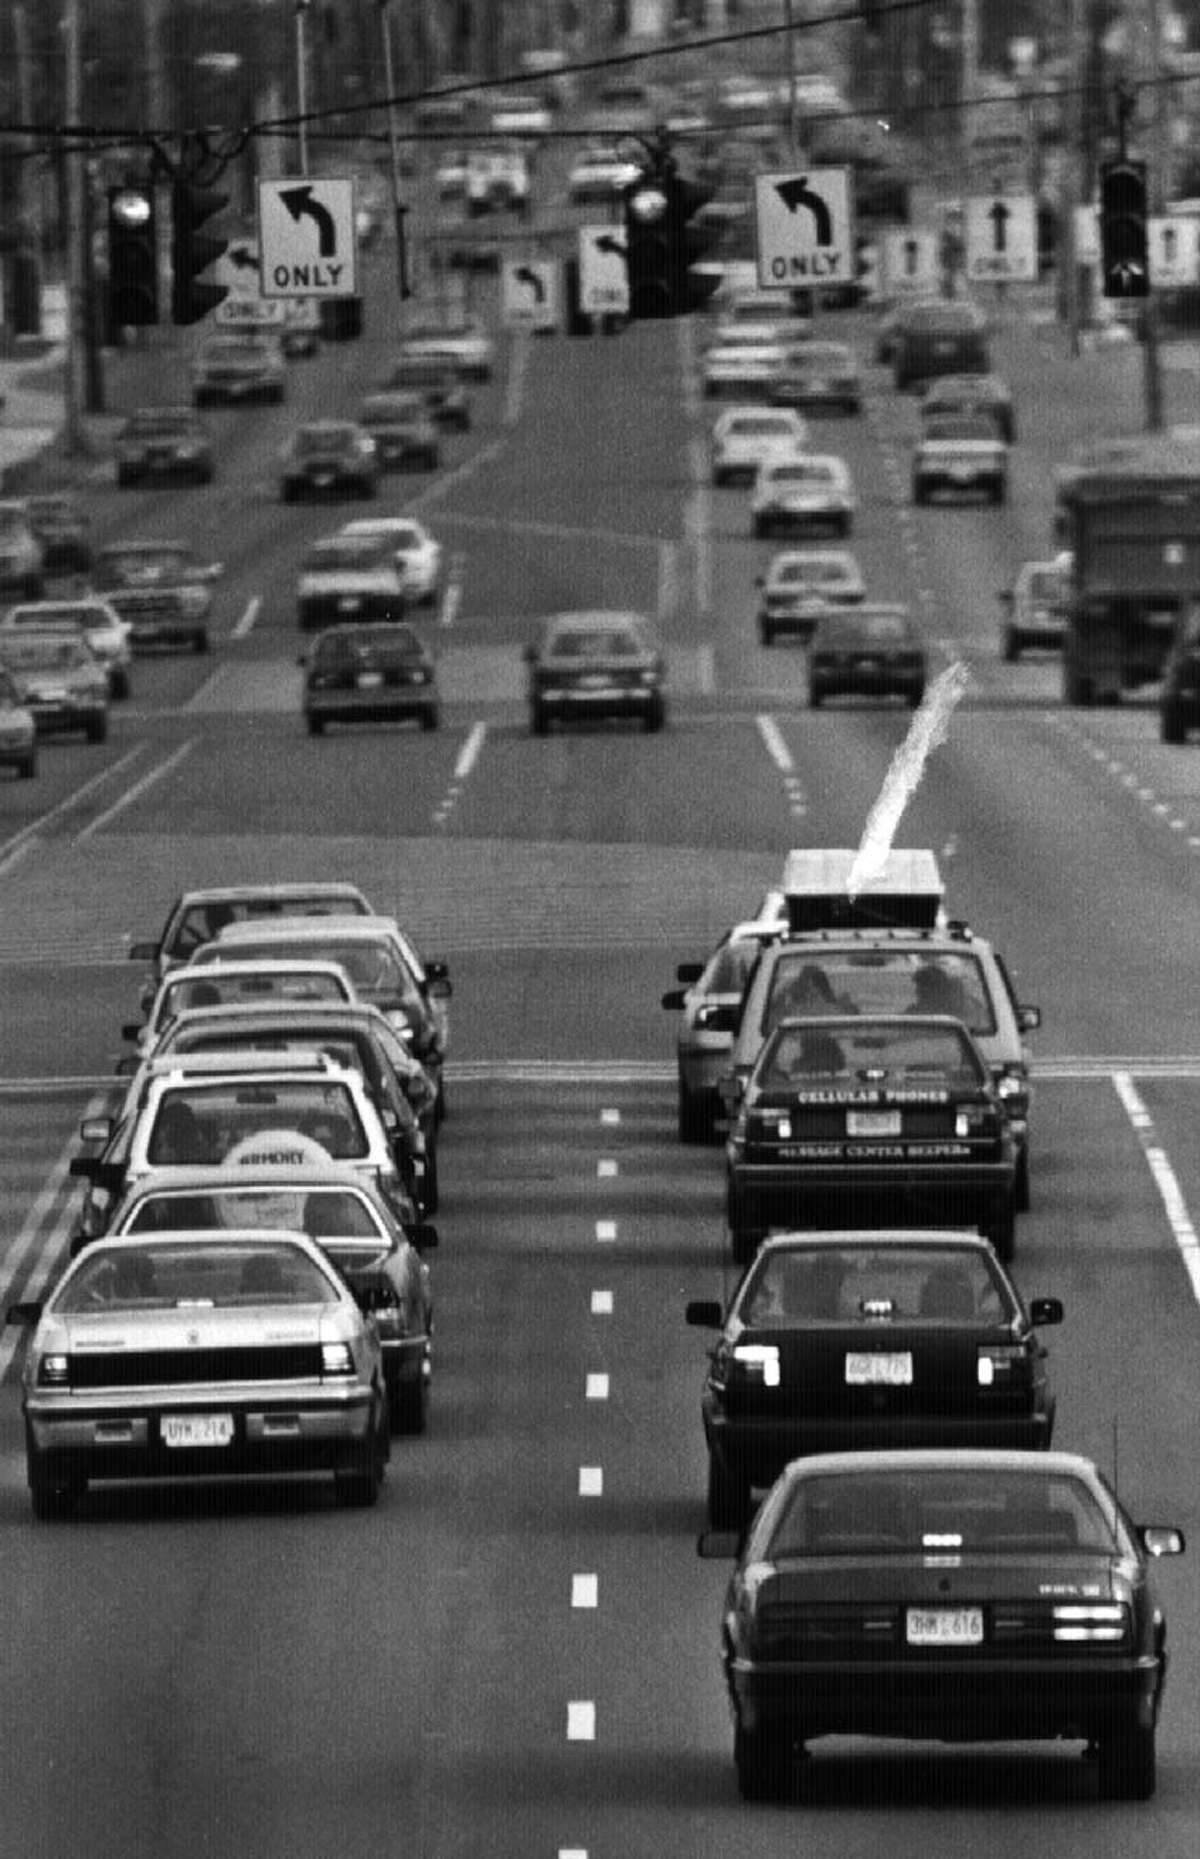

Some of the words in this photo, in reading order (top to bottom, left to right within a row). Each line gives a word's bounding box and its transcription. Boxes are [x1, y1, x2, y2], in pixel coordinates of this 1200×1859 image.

[273, 264, 343, 287] ONLY
[773, 252, 840, 279] ONLY
[798, 1090, 879, 1104] CELLULAR
[885, 1090, 948, 1103] PHONES
[846, 1145, 904, 1157] CENTER
[952, 1614, 980, 1635] 616
